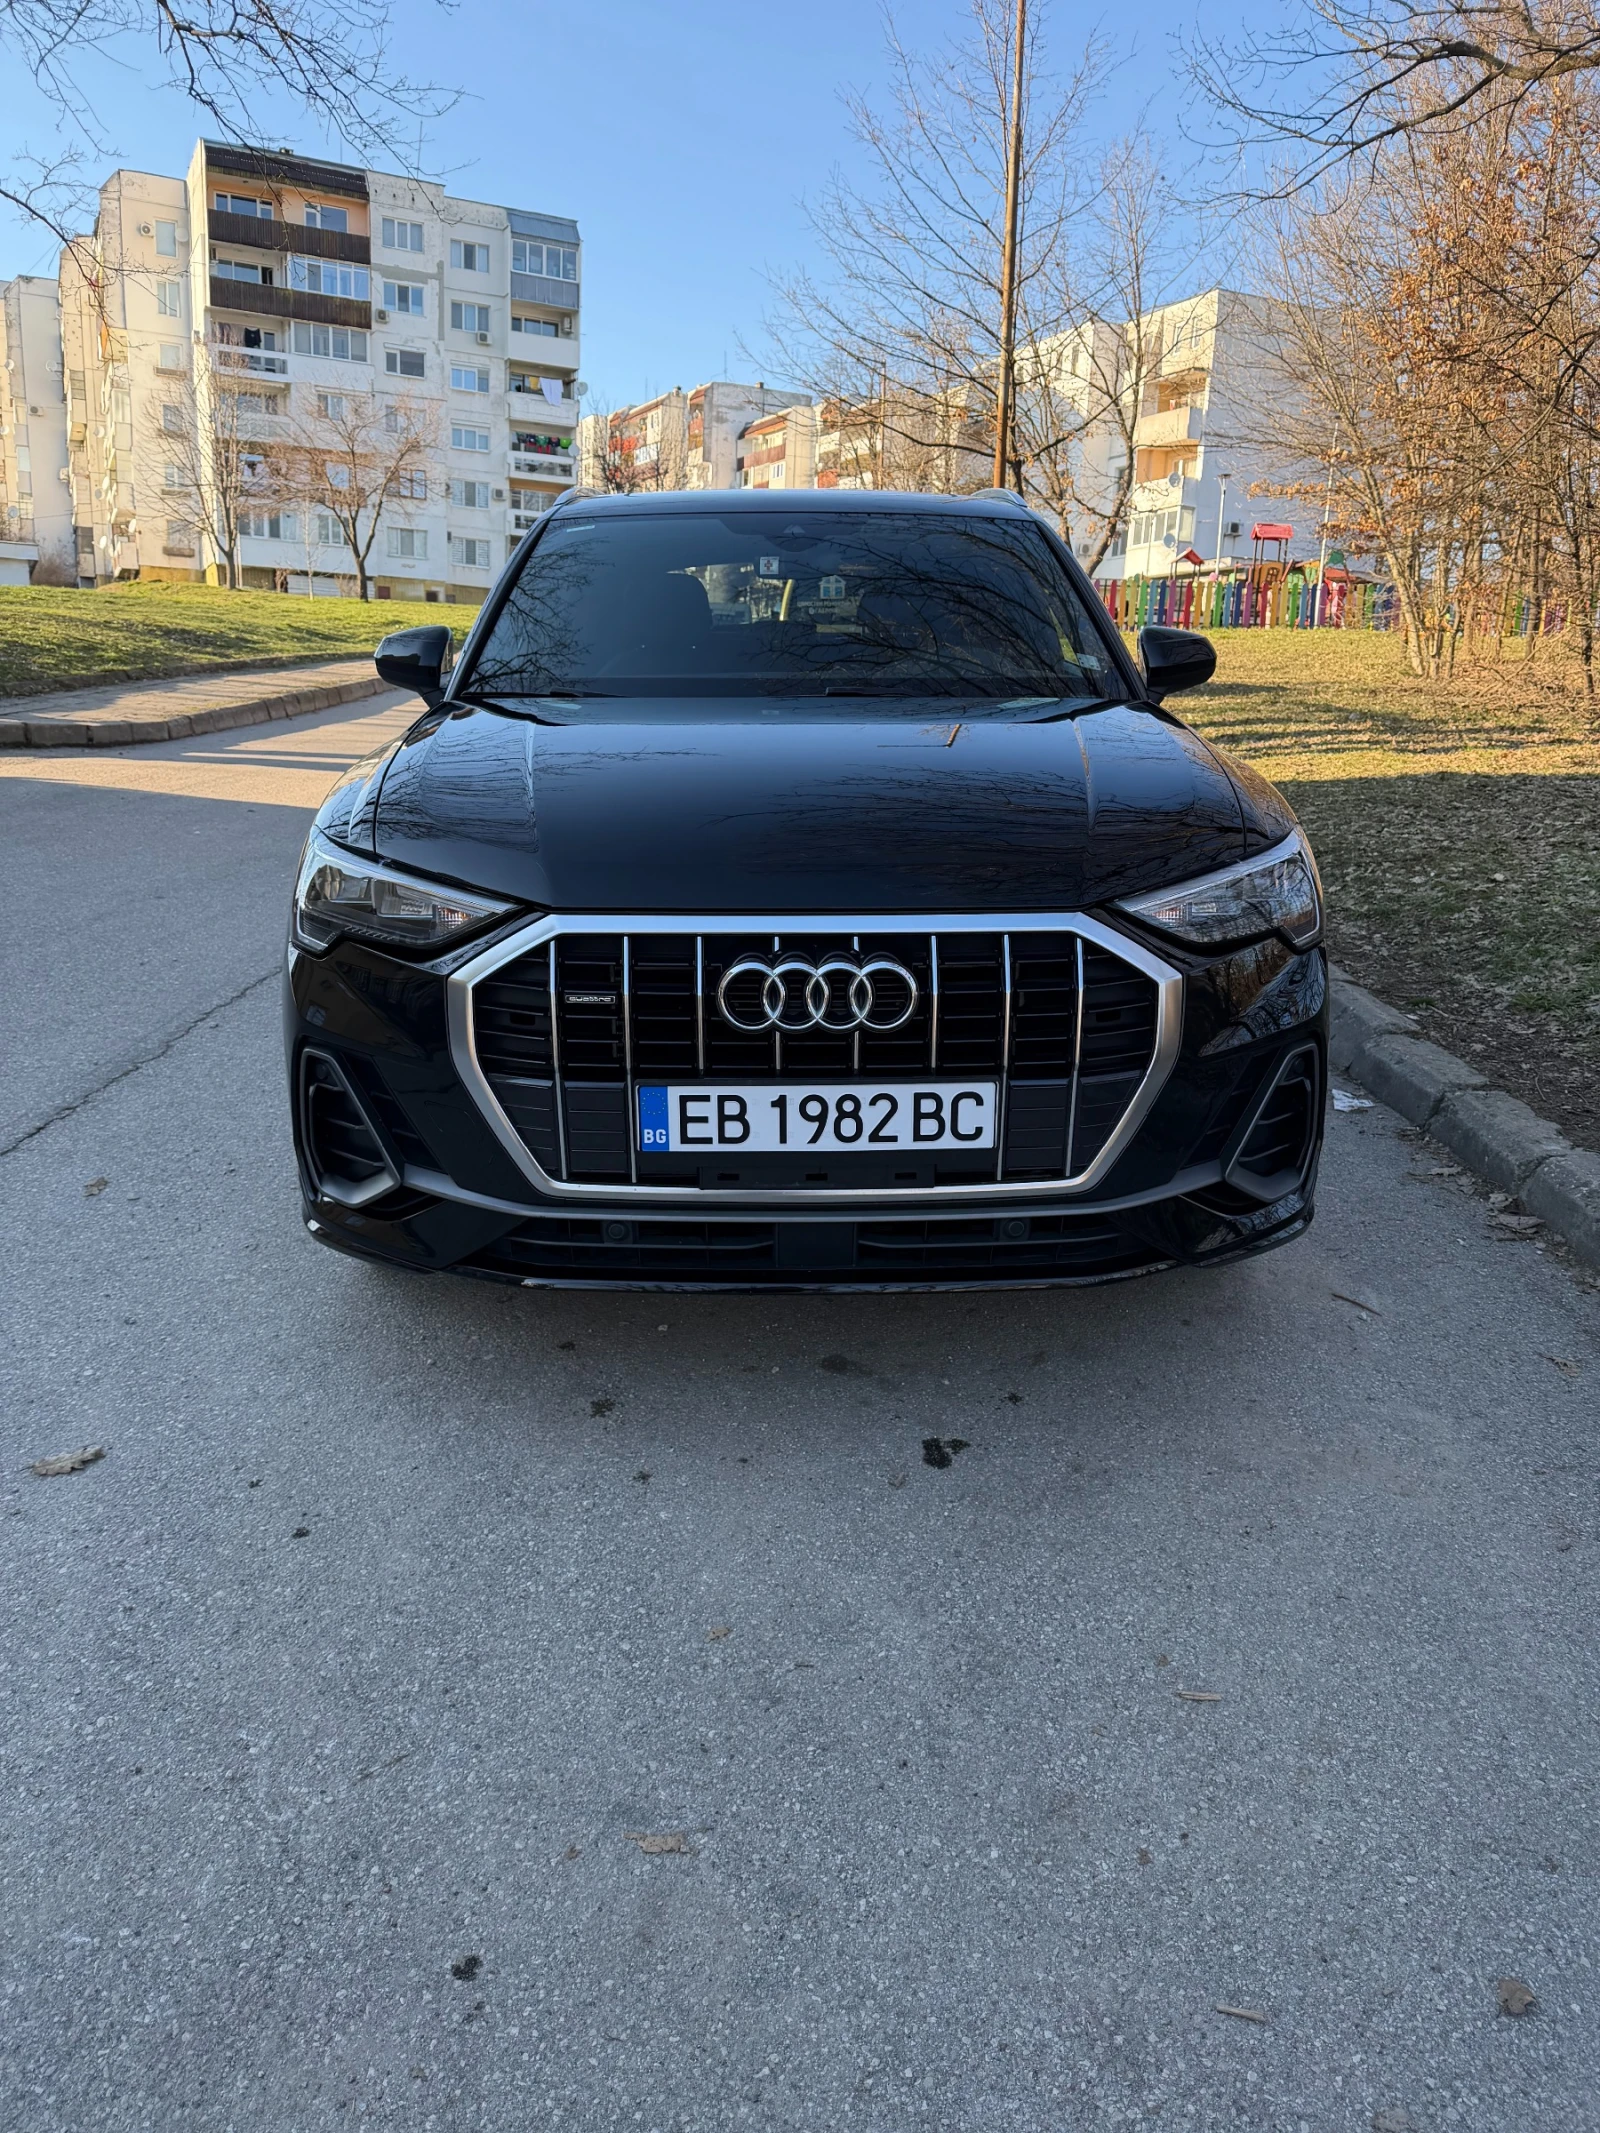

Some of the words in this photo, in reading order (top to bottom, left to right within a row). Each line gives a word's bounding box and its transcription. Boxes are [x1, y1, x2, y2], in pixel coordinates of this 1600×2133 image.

[678, 1094, 751, 1145] EB
[770, 1093, 899, 1145] 1982
[912, 1091, 985, 1143] BC
[643, 1128, 667, 1144] BG
